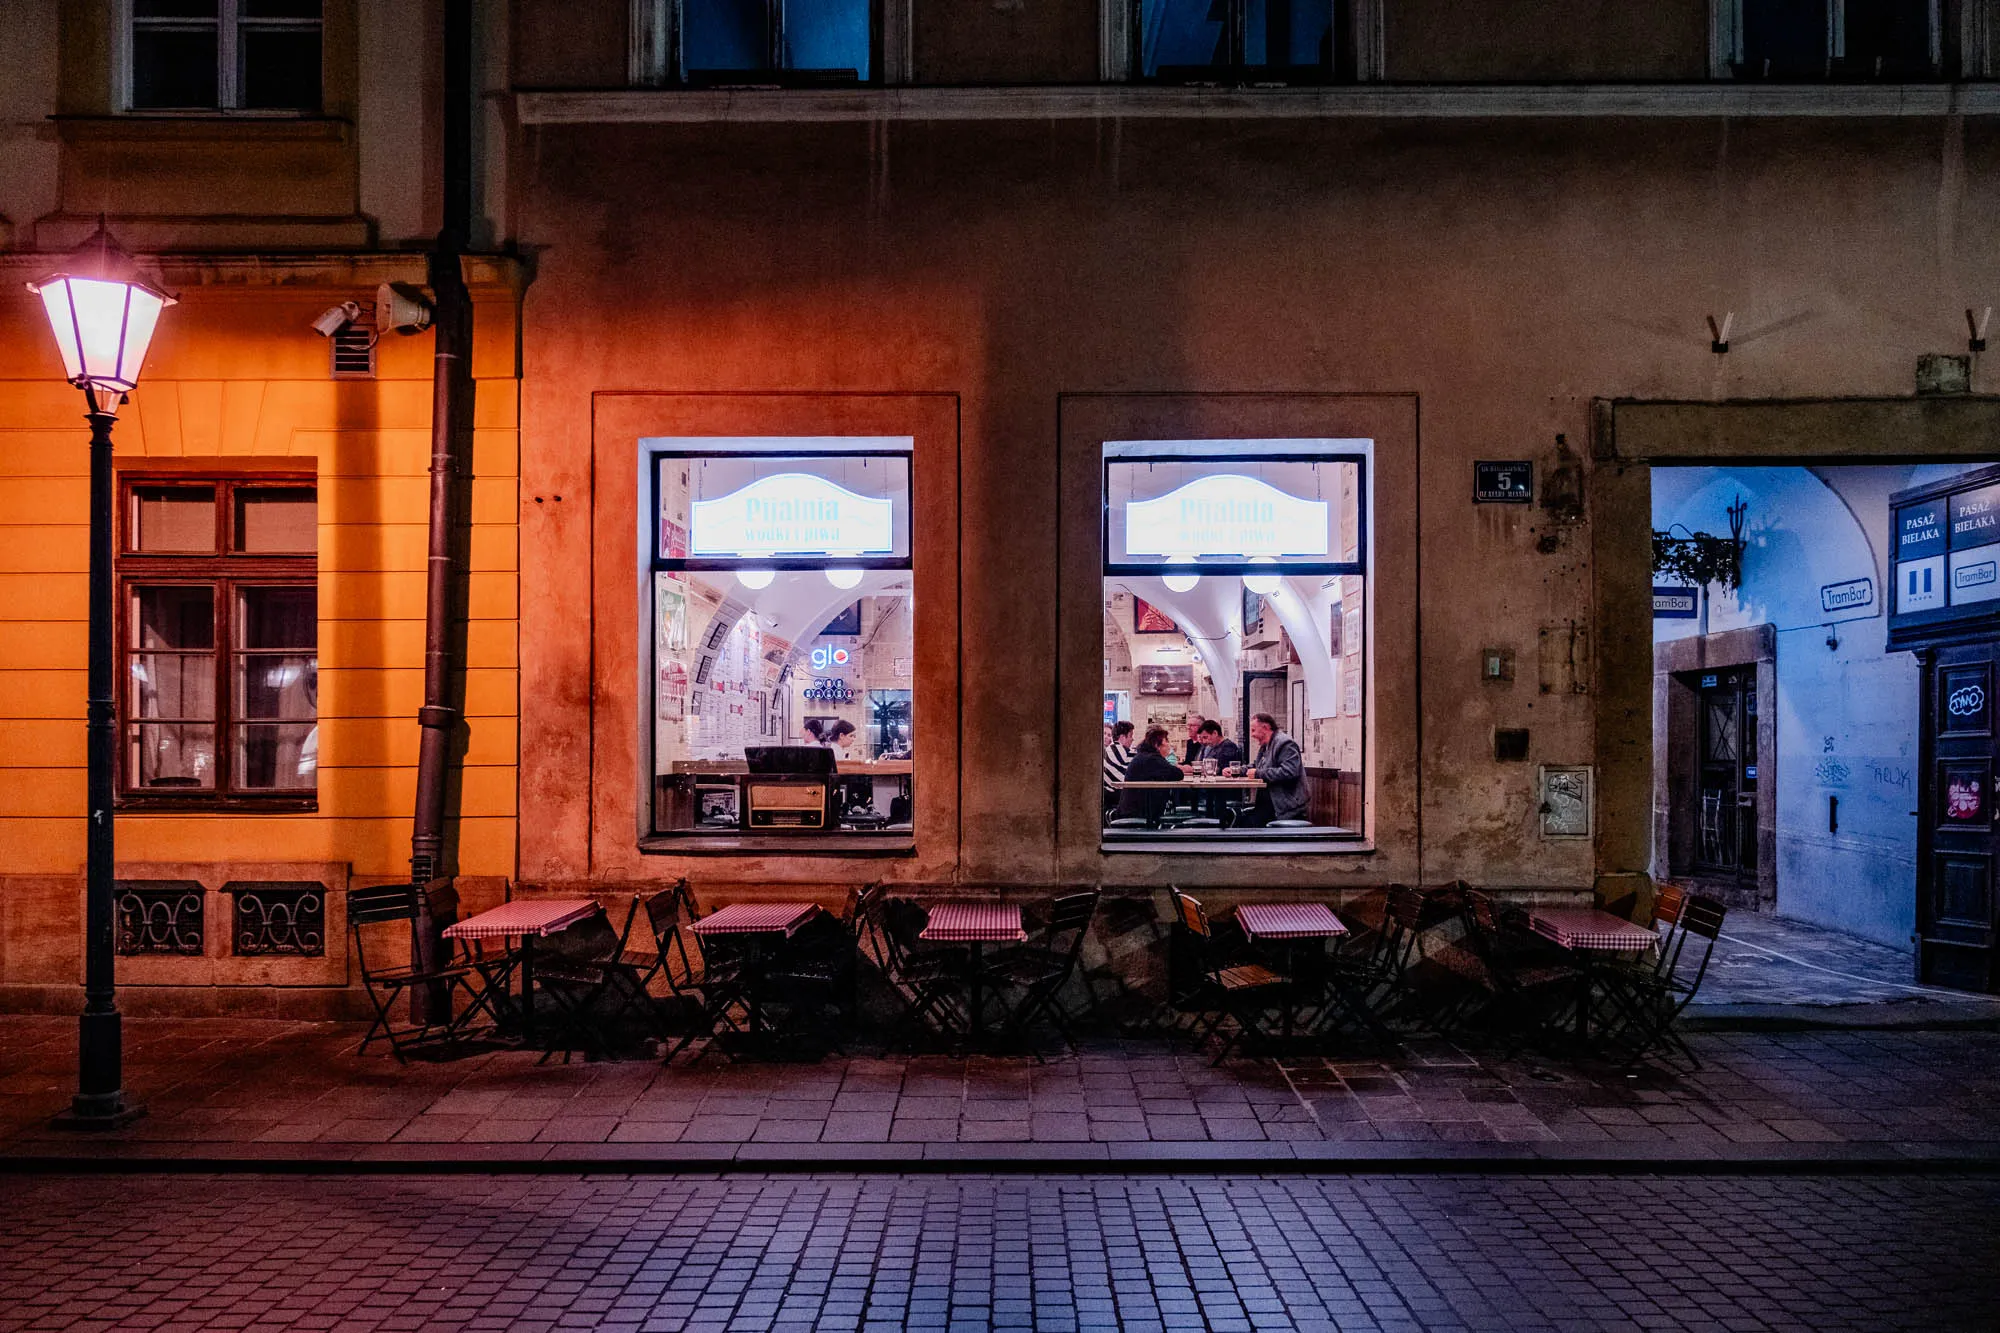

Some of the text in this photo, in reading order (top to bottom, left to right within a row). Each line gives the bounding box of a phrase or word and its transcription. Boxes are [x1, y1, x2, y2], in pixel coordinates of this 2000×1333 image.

[1497, 472, 1511, 490] 5
[746, 497, 839, 524] Pijalnia
[1959, 500, 1990, 518] PASAŻ
[1906, 512, 1936, 530] PASAŻ
[1954, 515, 1996, 534] BIELAKA
[1902, 528, 1940, 545] BIELAKA
[1957, 567, 1992, 584] TramBar
[1654, 597, 1689, 609] amBar
[1826, 586, 1866, 605] TramBar
[811, 643, 849, 670] glo
